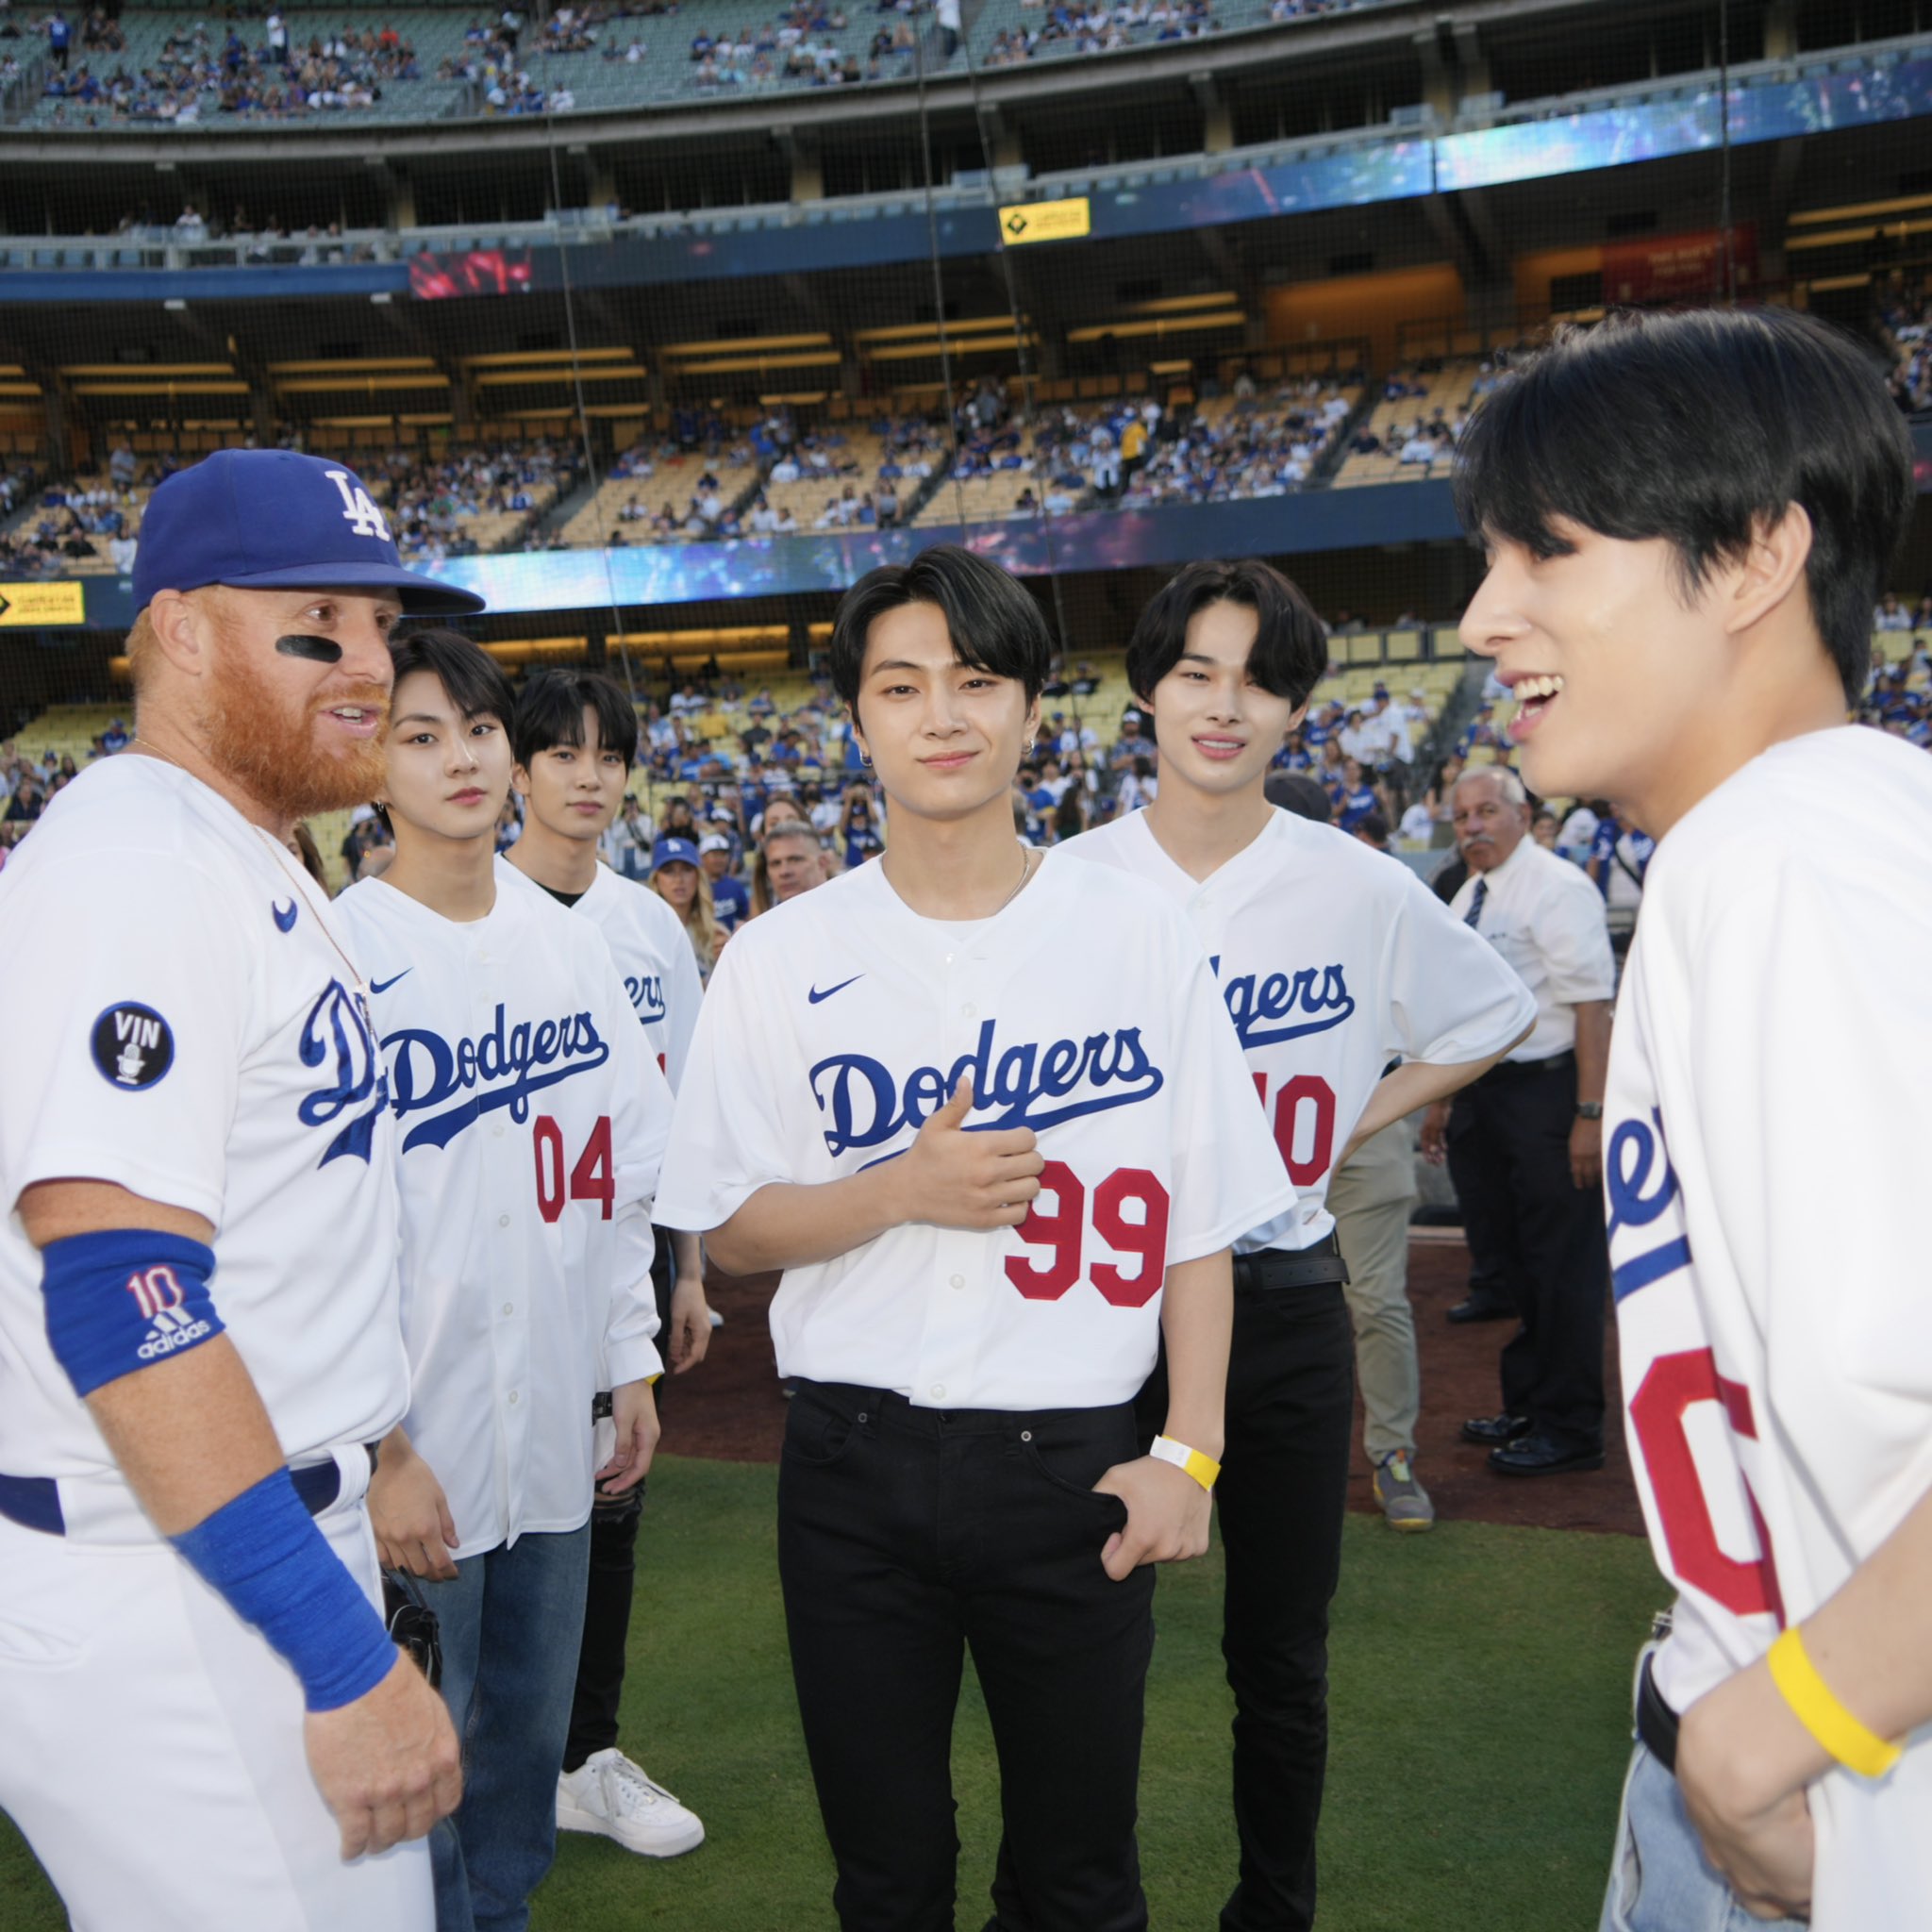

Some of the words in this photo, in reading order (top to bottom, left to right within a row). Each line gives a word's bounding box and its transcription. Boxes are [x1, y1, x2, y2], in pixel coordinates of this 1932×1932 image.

[325, 471, 391, 541] LA
[115, 1011, 160, 1049] VIN
[379, 1003, 609, 1124] Dodgers
[809, 1019, 1164, 1158] Dodgers
[533, 1115, 615, 1224] 04
[1005, 1159, 1170, 1307] 99
[126, 1265, 184, 1320] 10
[137, 1319, 211, 1358] adidas
